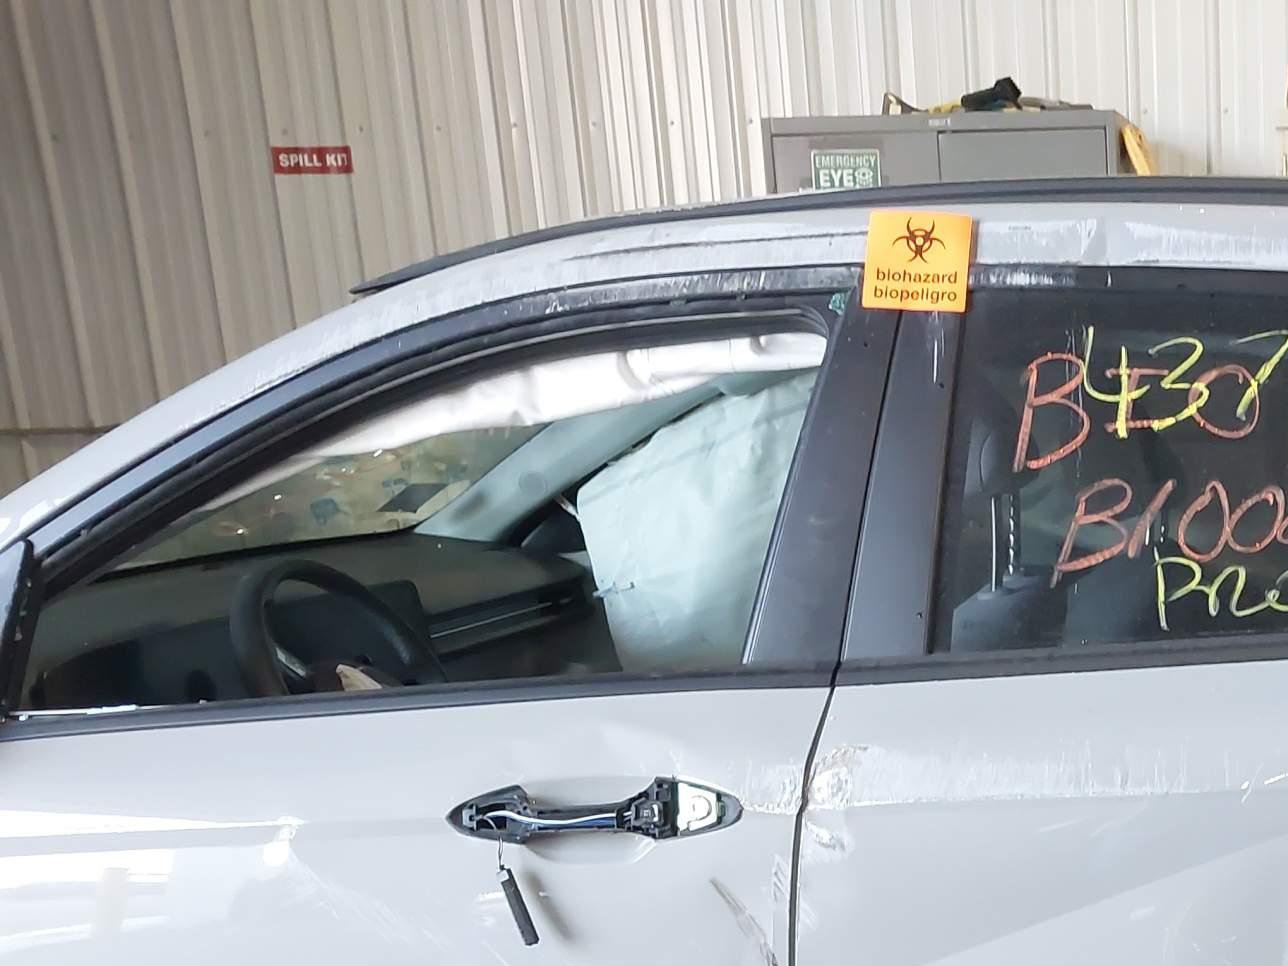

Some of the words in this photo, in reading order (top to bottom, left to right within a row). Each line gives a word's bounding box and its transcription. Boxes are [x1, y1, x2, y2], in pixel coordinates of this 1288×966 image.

[278, 153, 322, 168] SPILL
[815, 154, 876, 169] EMERGENCY
[819, 168, 854, 188] EYE
[876, 266, 958, 284] biohazard
[873, 285, 957, 304] biopeligro
